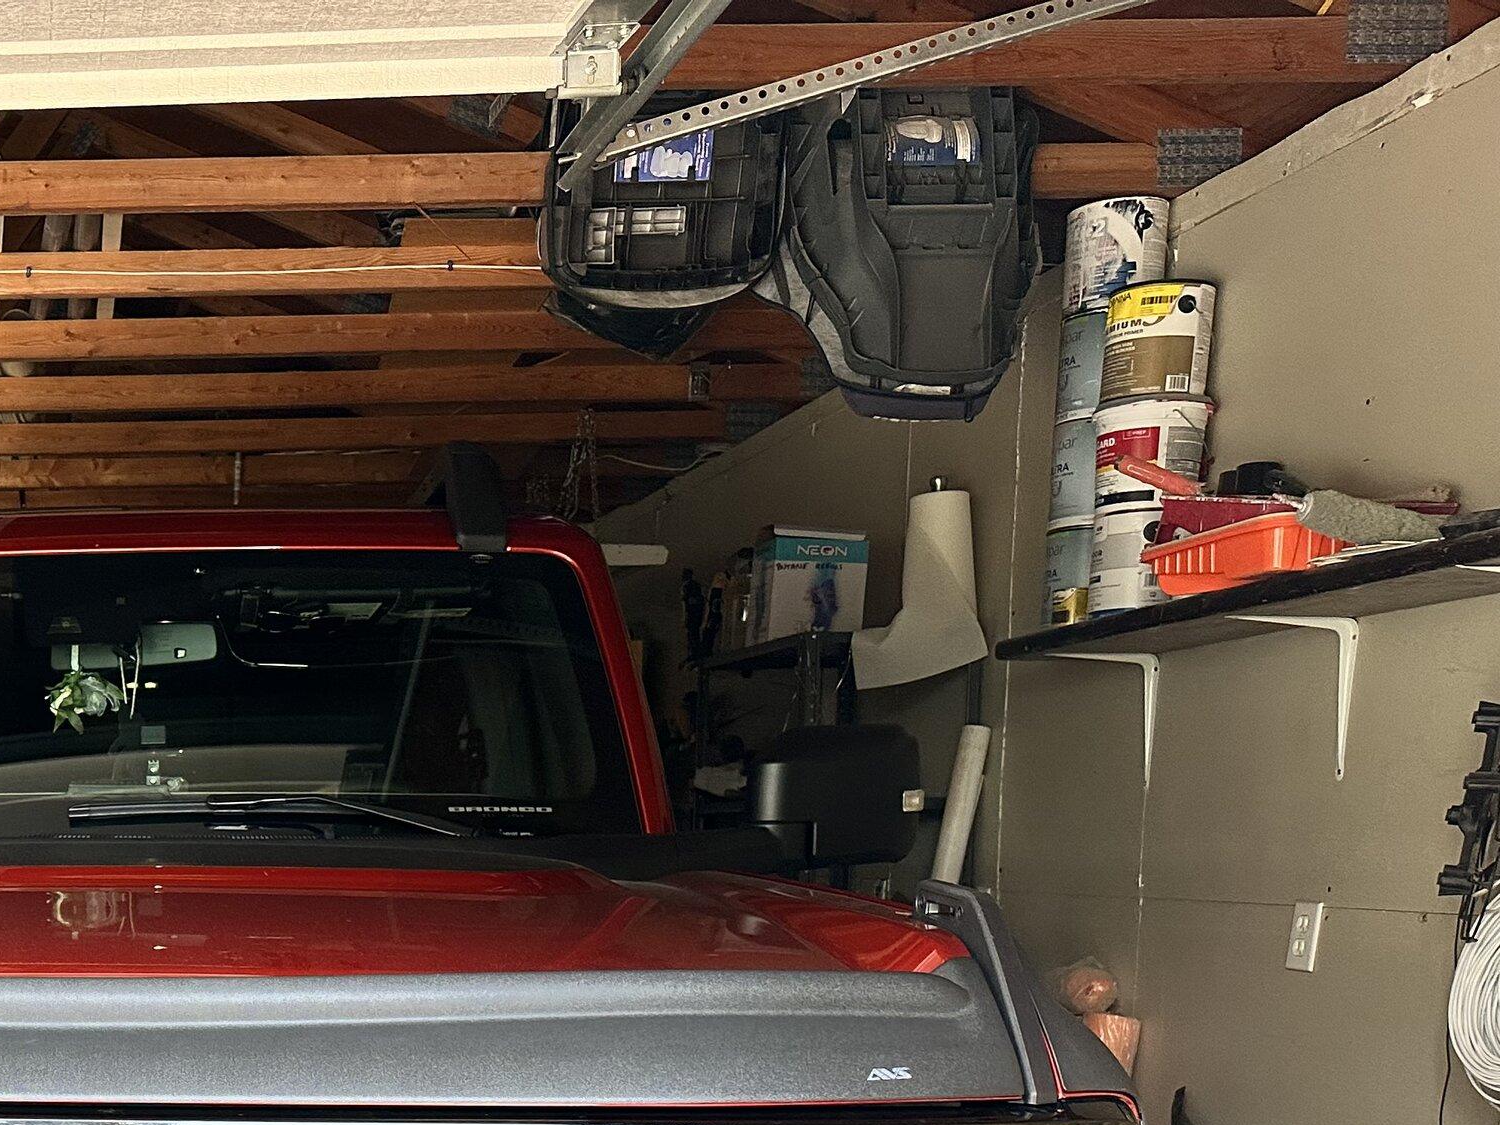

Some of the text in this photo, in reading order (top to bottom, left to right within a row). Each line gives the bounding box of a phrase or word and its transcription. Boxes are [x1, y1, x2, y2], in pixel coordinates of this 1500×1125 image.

[1105, 319, 1142, 335] MIUM
[797, 545, 848, 557] NEON
[866, 1067, 913, 1081] AVS
